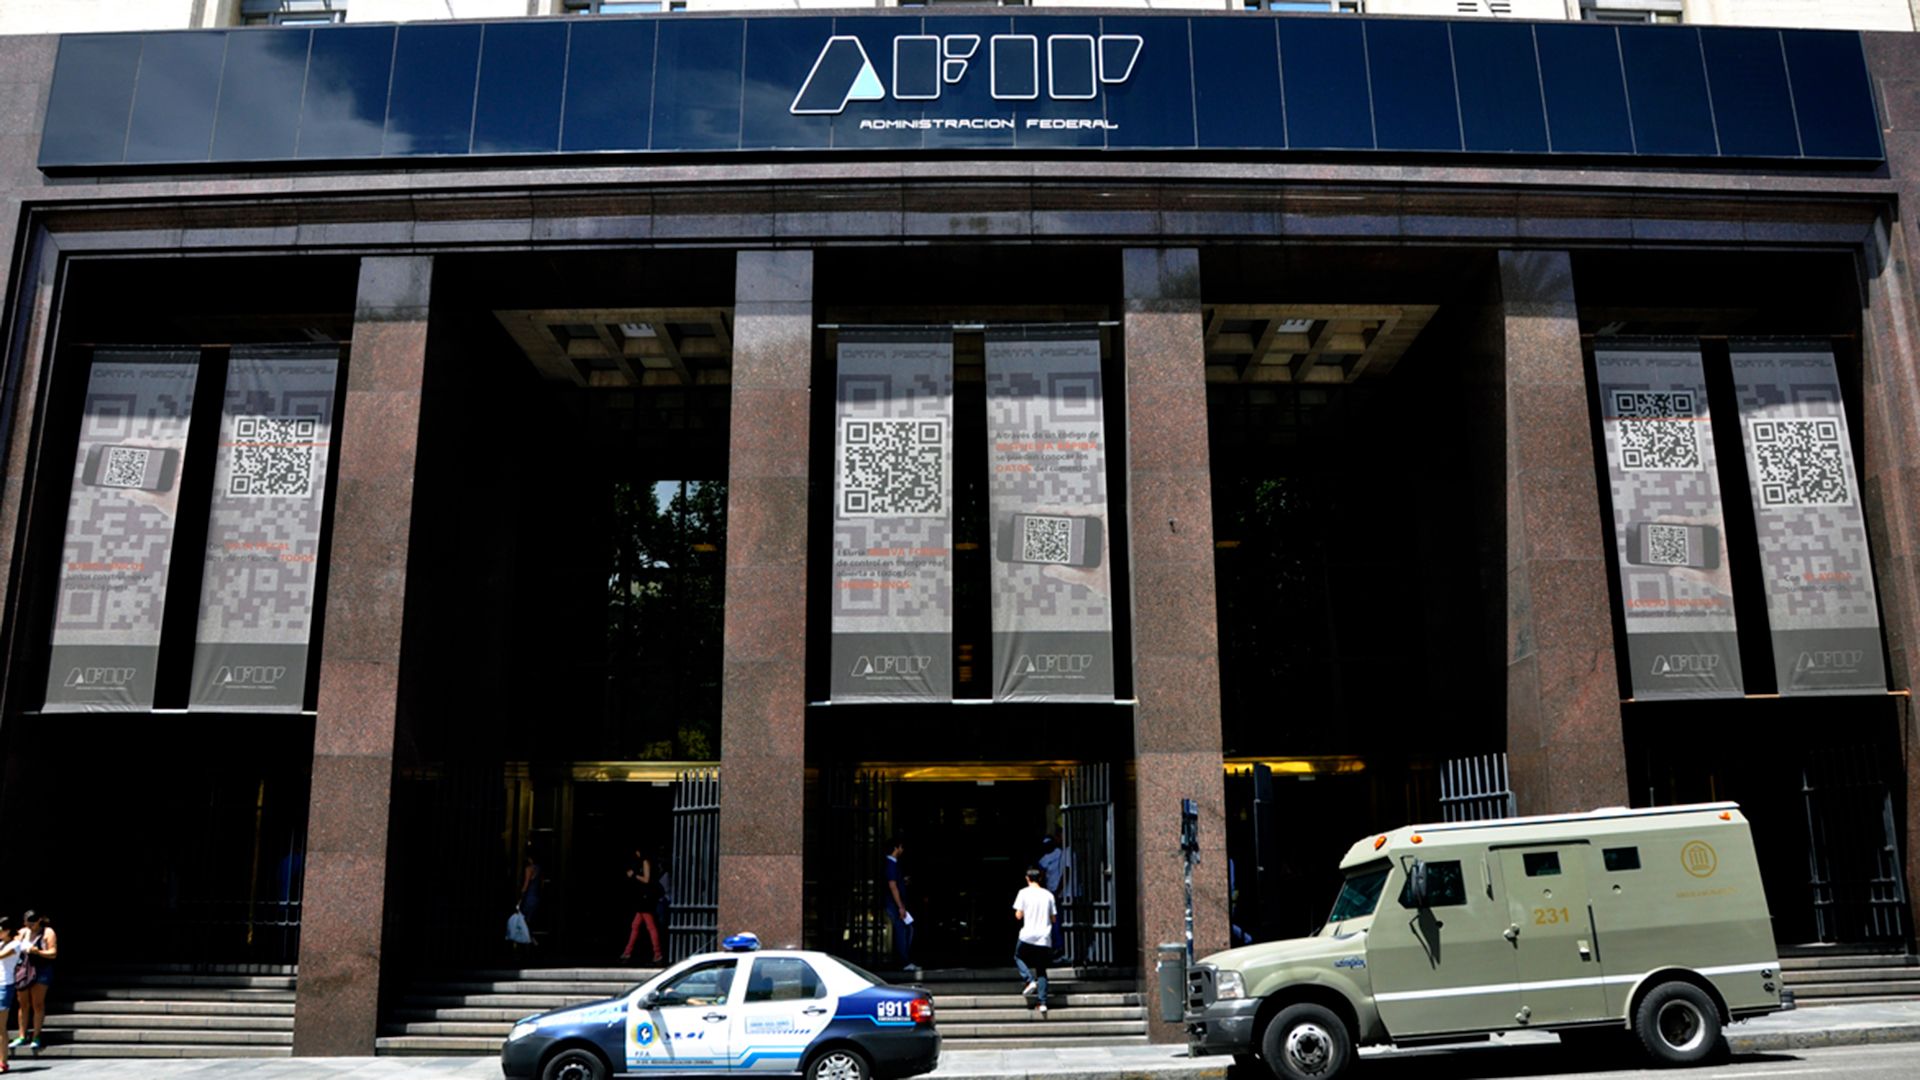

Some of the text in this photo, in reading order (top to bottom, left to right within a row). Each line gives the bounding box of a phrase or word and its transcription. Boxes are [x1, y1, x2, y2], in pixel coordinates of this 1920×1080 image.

[790, 34, 1144, 113] AFIP
[860, 118, 1119, 130] ADMINISTRACION FEDERAL
[851, 655, 931, 677] AFIP
[1013, 654, 1093, 675] AFIP
[1651, 654, 1720, 675] AFIP
[1795, 650, 1865, 672] AFIP
[64, 667, 136, 687] AFIP
[212, 666, 286, 685] AFIP
[1534, 906, 1569, 925] 231
[886, 1001, 911, 1017] 911
